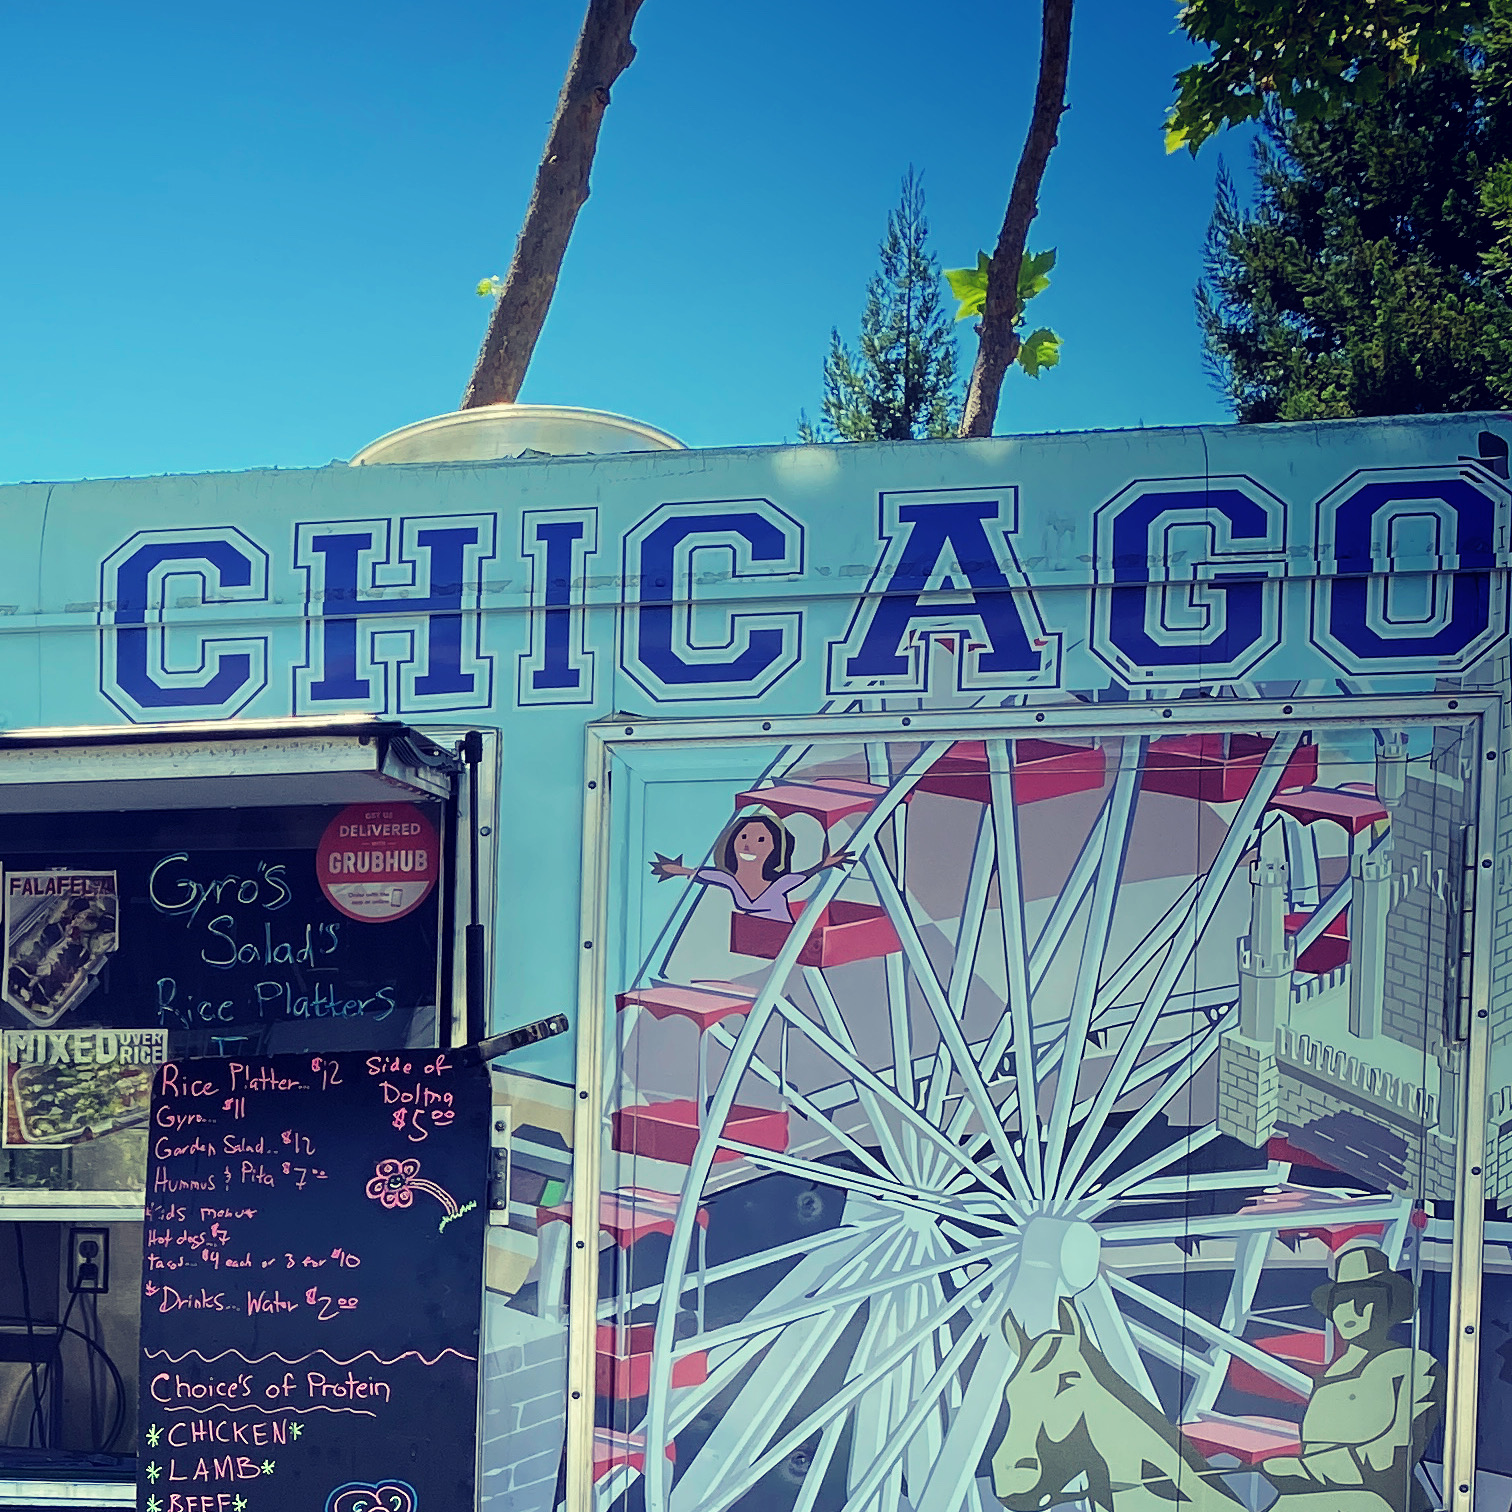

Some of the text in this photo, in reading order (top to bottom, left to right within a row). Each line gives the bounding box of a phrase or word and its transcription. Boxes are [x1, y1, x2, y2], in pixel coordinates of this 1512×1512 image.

[96, 464, 1511, 724] CHICAGO
[339, 823, 420, 838] DELIVERED
[329, 850, 428, 874] GRUBHUB
[10, 877, 94, 896] FALAFEL
[157, 977, 395, 1029] Rice Platters
[8, 1033, 118, 1064] MIXED
[120, 1033, 163, 1045] OVER
[120, 1046, 163, 1064] RICE
[366, 1054, 453, 1076] Side of
[161, 1063, 220, 1097] Rice
[312, 1057, 343, 1091] $12
[222, 1097, 246, 1120] $11
[154, 1136, 216, 1160] Garden
[280, 1128, 316, 1156] $12
[154, 1165, 216, 1193] Hummus
[241, 1160, 275, 1188] Pita
[148, 1228, 174, 1248] Hot
[284, 1252, 296, 1269] 3
[248, 1290, 299, 1316] Water
[150, 1371, 391, 1402] Choice's of Protein
[168, 1418, 288, 1448] CHICKEN
[168, 1454, 261, 1482] LAMB
